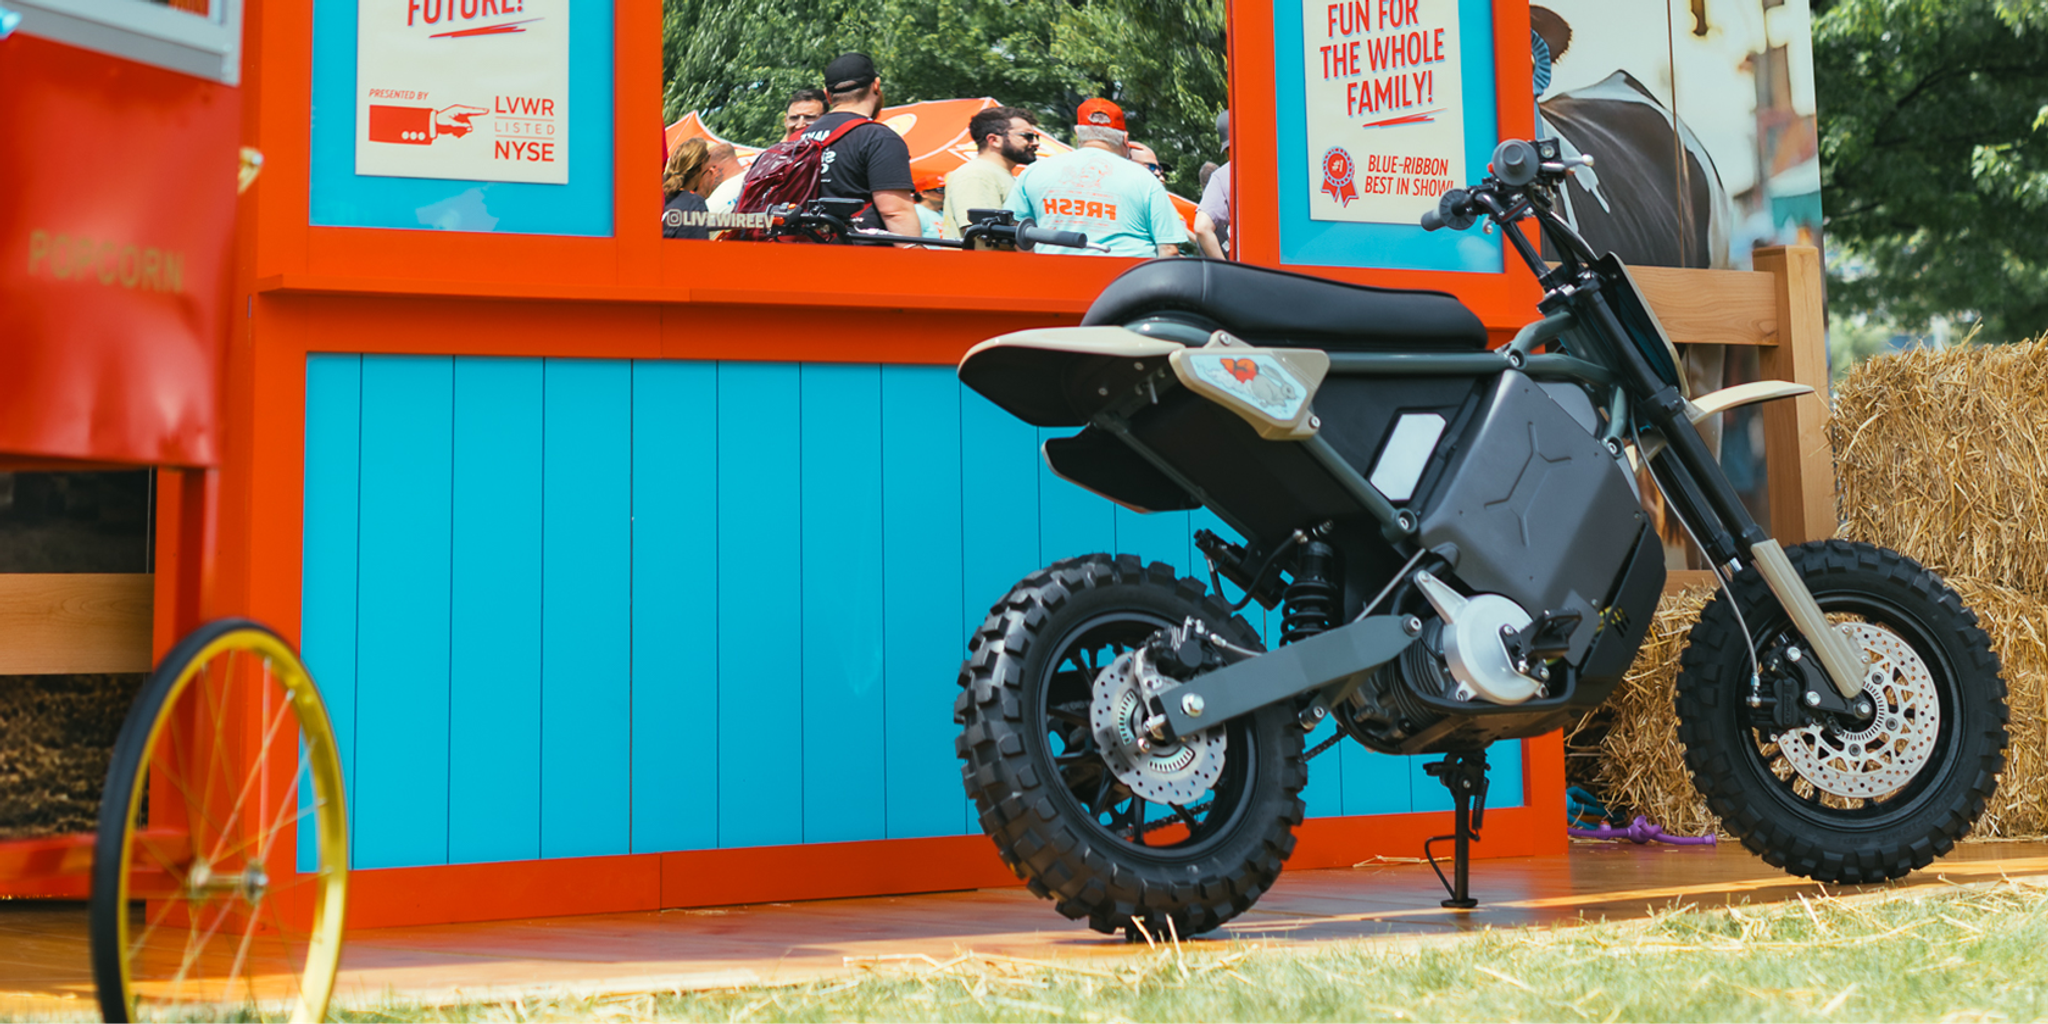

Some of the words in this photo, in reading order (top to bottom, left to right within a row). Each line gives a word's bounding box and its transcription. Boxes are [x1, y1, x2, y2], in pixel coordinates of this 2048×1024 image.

[1328, 0, 1371, 38] FUN
[1378, 0, 1419, 30] FOR
[1319, 41, 1361, 79] THE
[1367, 28, 1445, 71] WHOLE
[369, 88, 416, 100] PRESENTED
[417, 91, 430, 101] BY
[1347, 70, 1433, 116] FAMILY!
[495, 95, 555, 117] LVWR
[494, 121, 555, 136] LISTED
[494, 140, 555, 162] NYSE
[1368, 154, 1449, 177] BLUE-RIBBON
[1364, 175, 1394, 195] BEST
[1396, 177, 1410, 196] IN
[27, 228, 184, 294] POPCORN
